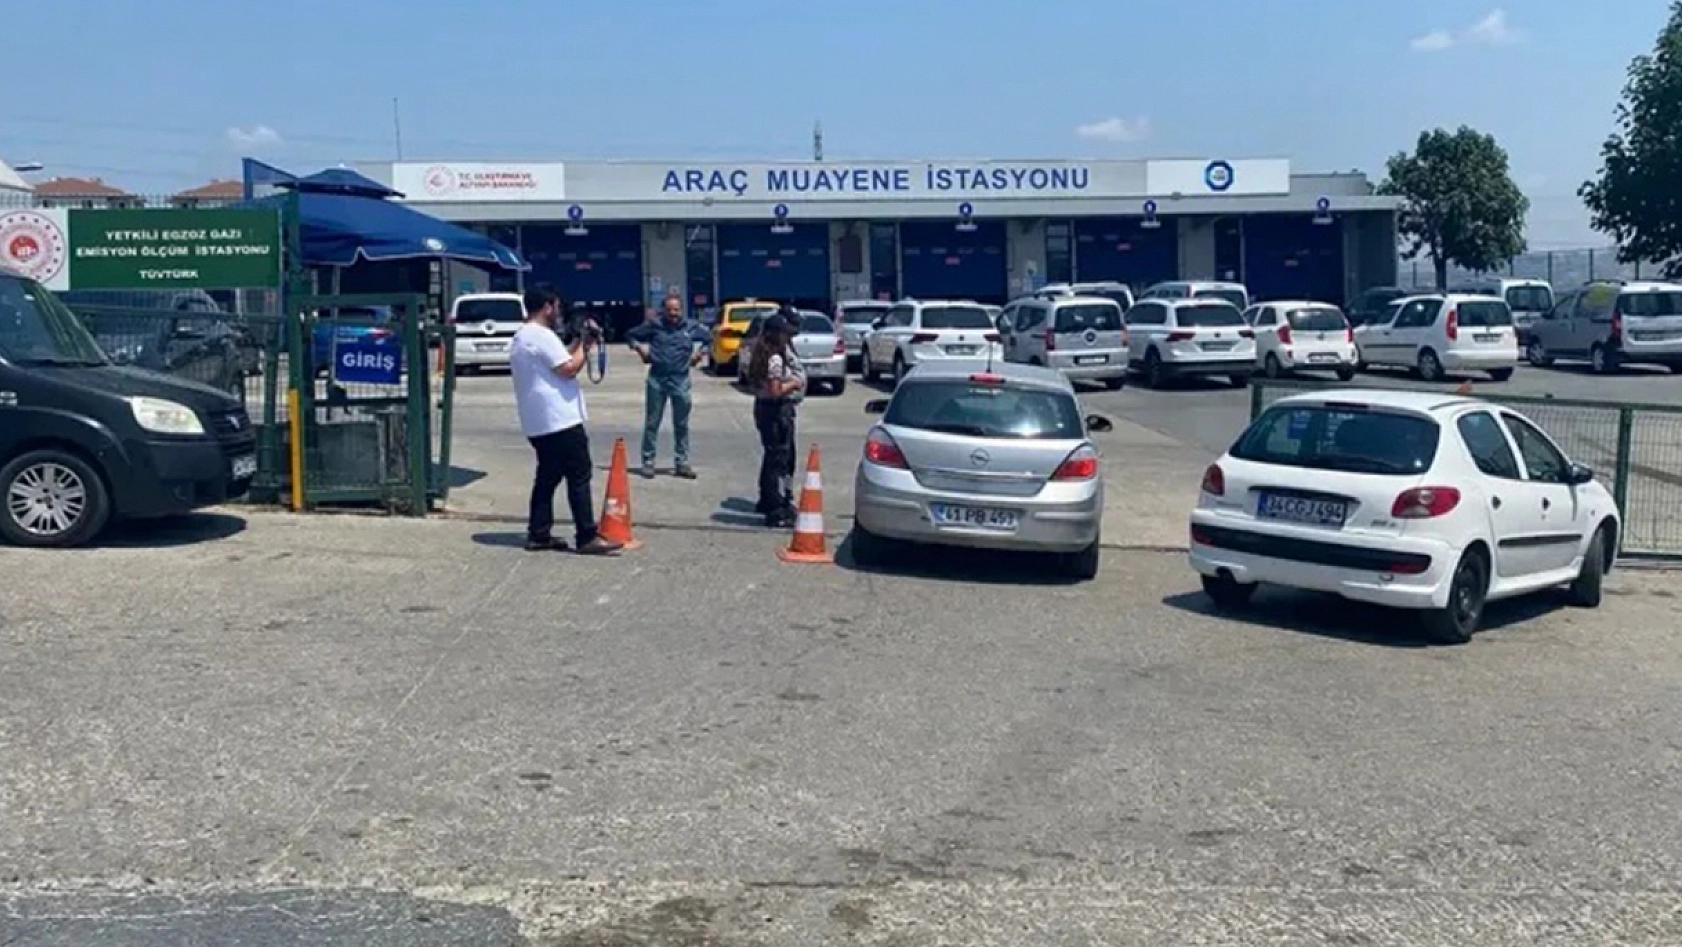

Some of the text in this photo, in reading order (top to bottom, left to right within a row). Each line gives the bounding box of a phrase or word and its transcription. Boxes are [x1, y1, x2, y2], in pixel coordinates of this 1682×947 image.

[662, 164, 1089, 197] ARAÇ MUAYENE İSTASYONU
[105, 228, 159, 240] YETKİLİ
[162, 228, 206, 240] EGZOZ
[76, 243, 270, 258] EMİSYON ÖLÇÜM İSTASYONU
[139, 268, 199, 279] TÜVTÜRK
[342, 349, 395, 373] GİRİŞ
